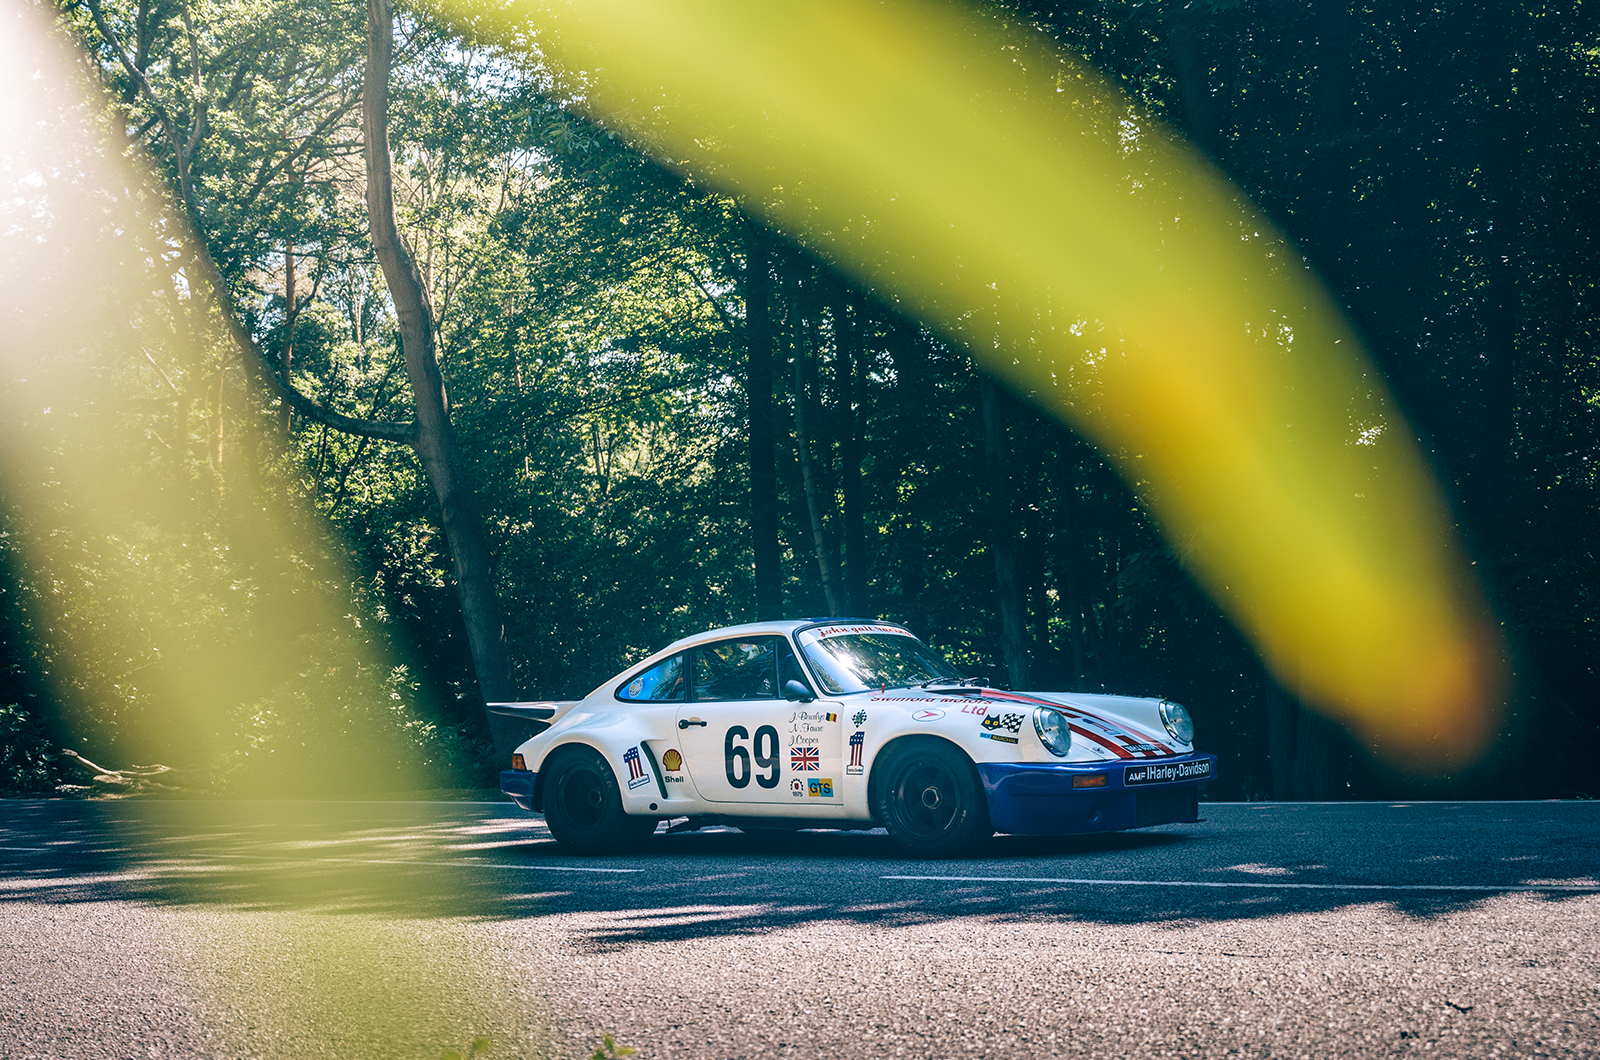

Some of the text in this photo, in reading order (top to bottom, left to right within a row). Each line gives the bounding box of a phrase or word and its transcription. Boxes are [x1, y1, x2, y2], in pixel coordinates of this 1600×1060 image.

[961, 704, 988, 716] Ltd
[724, 725, 781, 789] 69
[664, 775, 684, 783] Shell
[1128, 772, 1146, 781] AMF
[809, 783, 831, 794] GTS
[792, 790, 804, 798] 1975
